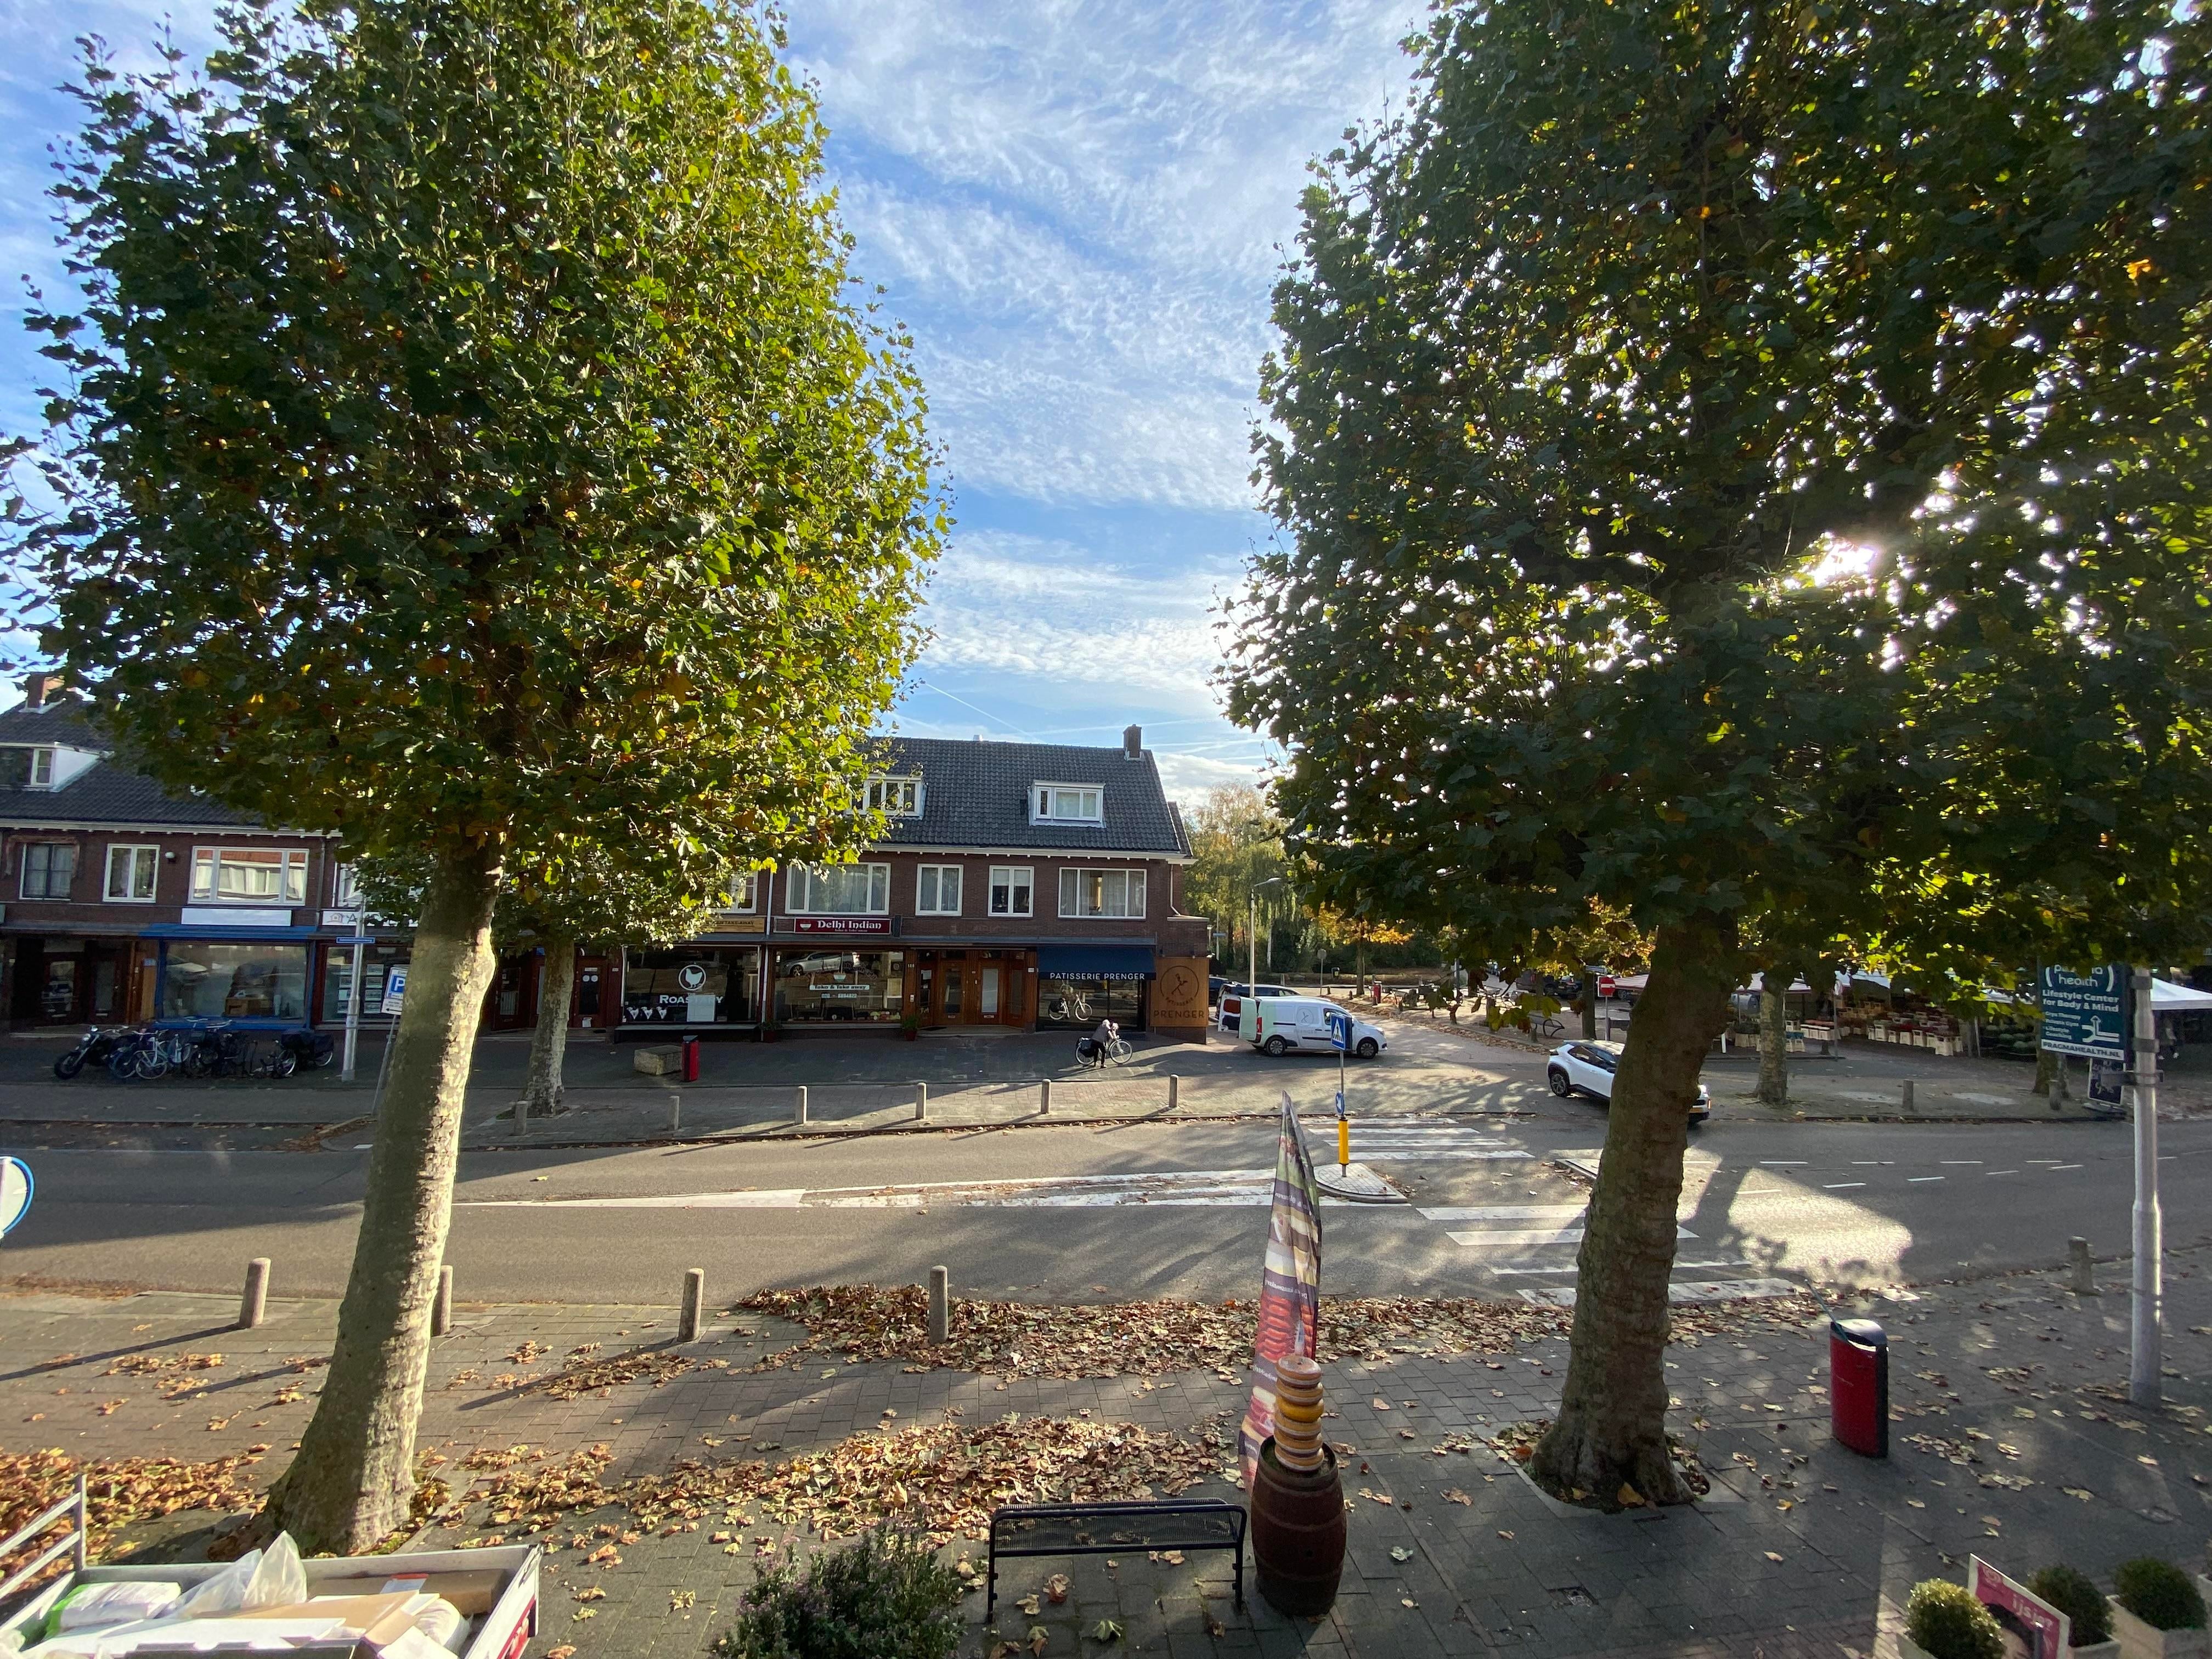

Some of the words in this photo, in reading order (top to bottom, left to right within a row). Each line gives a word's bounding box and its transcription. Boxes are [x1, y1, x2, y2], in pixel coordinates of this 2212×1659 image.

[817, 920, 845, 929] Delhi
[2042, 990, 2082, 1000] Lifestyle
[2084, 994, 2119, 1003] Center
[2057, 1000, 2081, 1009] Body
[2092, 1003, 2119, 1012] Mind
[1154, 1010, 1204, 1018] PRENGER
[2042, 1041, 2121, 1058] PRAGMAHEALTH.NL
